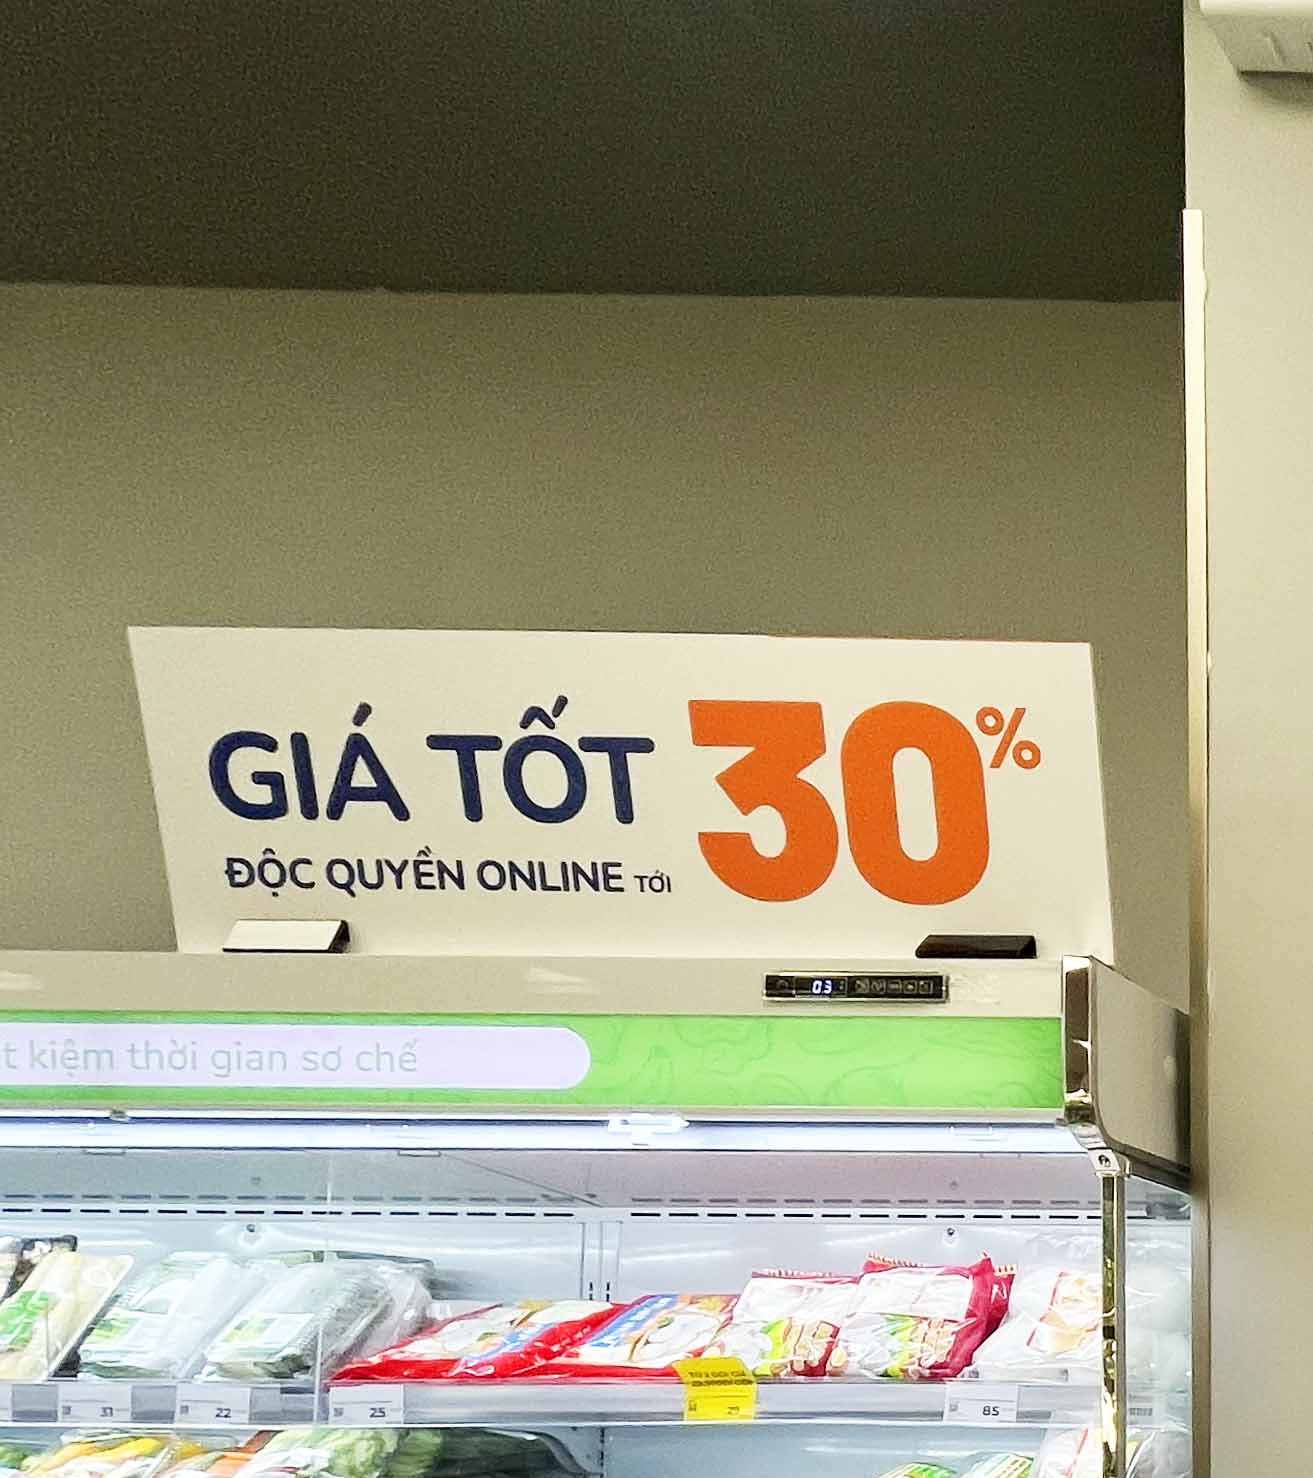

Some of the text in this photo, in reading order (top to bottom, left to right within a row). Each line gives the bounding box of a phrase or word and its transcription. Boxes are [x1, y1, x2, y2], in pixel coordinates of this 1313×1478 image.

[209, 695, 654, 824] GIÁ TỐT
[225, 846, 671, 897] ĐỘC QUYỀN ONLINE TỚI
[812, 980, 833, 994] 03
[30, 1039, 114, 1077] kiệm
[126, 1040, 196, 1070] thời
[211, 1041, 287, 1078] gian
[303, 1046, 342, 1071] sơ
[355, 1038, 418, 1072] chế
[215, 1406, 232, 1418] 22
[982, 1405, 999, 1417] 85
